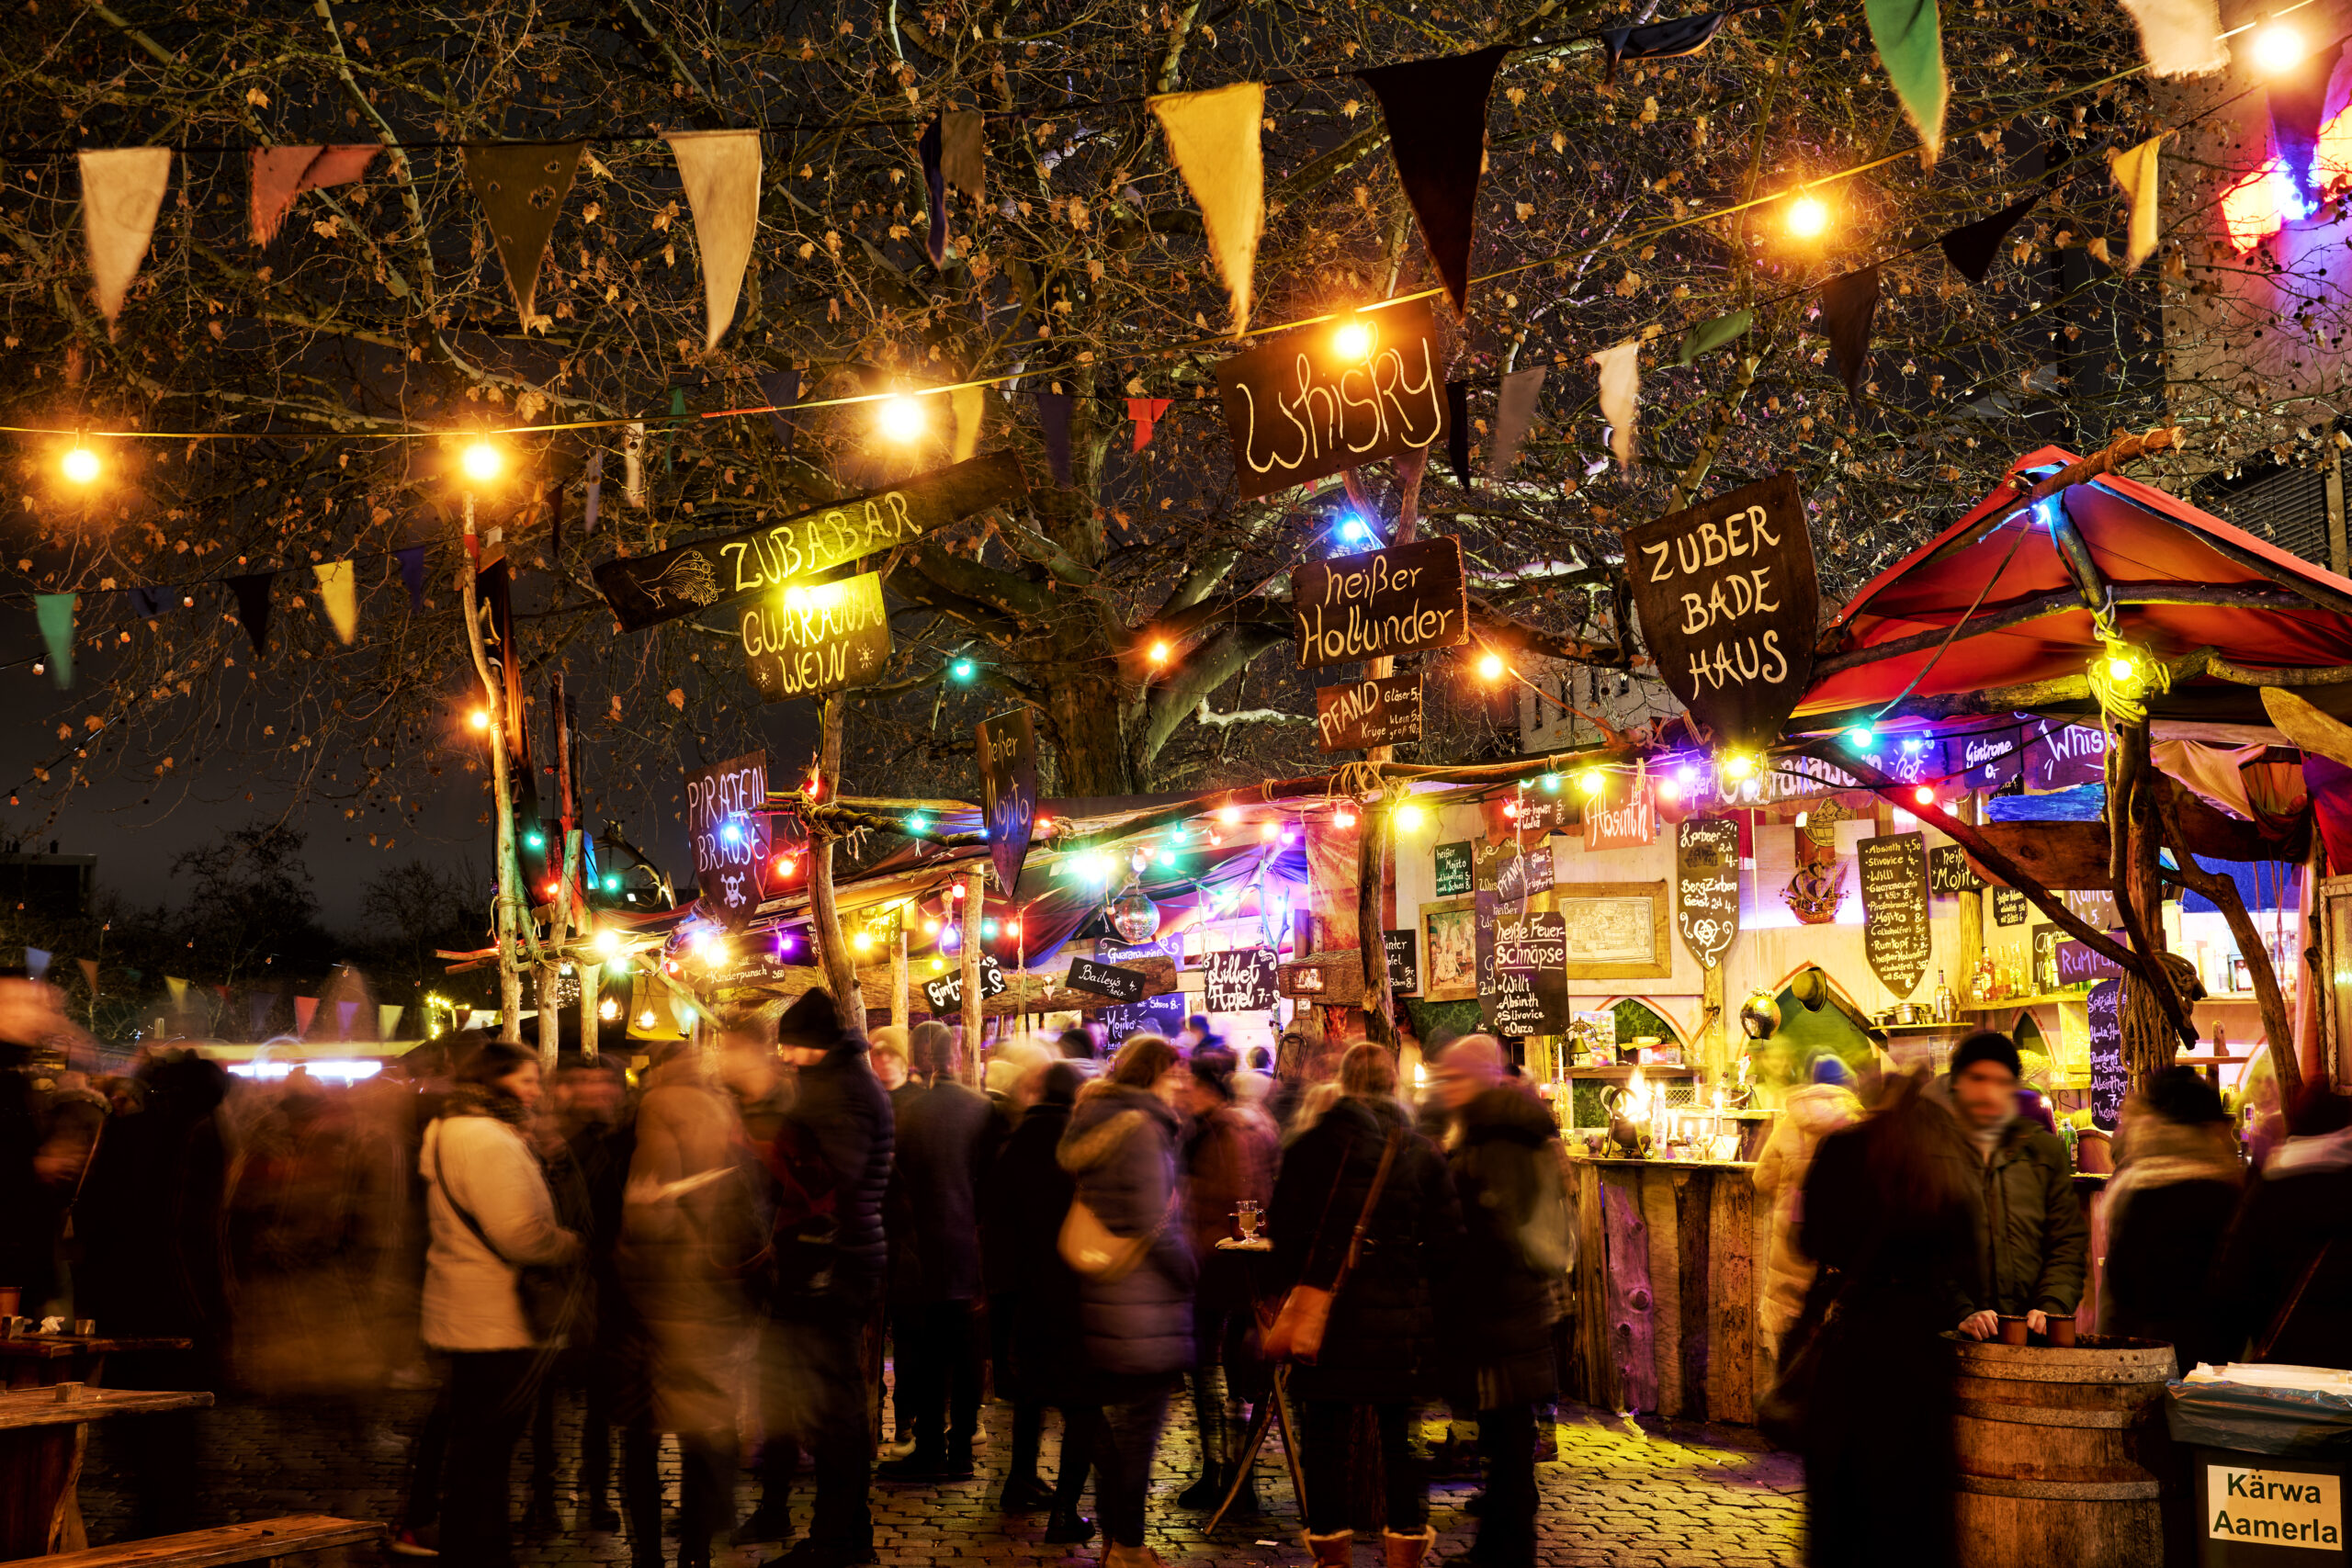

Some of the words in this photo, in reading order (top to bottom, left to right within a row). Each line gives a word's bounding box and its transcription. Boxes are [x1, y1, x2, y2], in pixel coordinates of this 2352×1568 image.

[1237, 321, 1441, 473] Whisky
[720, 491, 922, 592] ZUBABAR
[1641, 506, 1781, 582] ZUBER
[1324, 554, 1423, 608] heißer
[1680, 566, 1780, 634] BADE
[1298, 598, 1454, 665] Hollunder
[779, 641, 849, 694] WEIN
[1689, 629, 1787, 700] HAUS
[1320, 681, 1379, 747] PFAND
[1362, 722, 1385, 741] Krüge
[986, 728, 1018, 769] heißer
[2039, 719, 2116, 761] Whisk
[687, 765, 764, 831] PIRATEN
[986, 774, 1030, 840] Mojito
[1585, 783, 1647, 847] Absinth
[697, 823, 765, 872] BRAUSE
[1869, 842, 1901, 853] Absinth
[1943, 847, 1964, 869] heiß
[1479, 878, 1498, 892] Whis
[1383, 935, 1408, 950] inter
[1496, 944, 1564, 971] Schnäpse
[710, 964, 767, 984] Kinderpunsch
[2227, 1472, 2322, 1505] Kärwa
[2213, 1510, 2338, 1544] Aamerla
